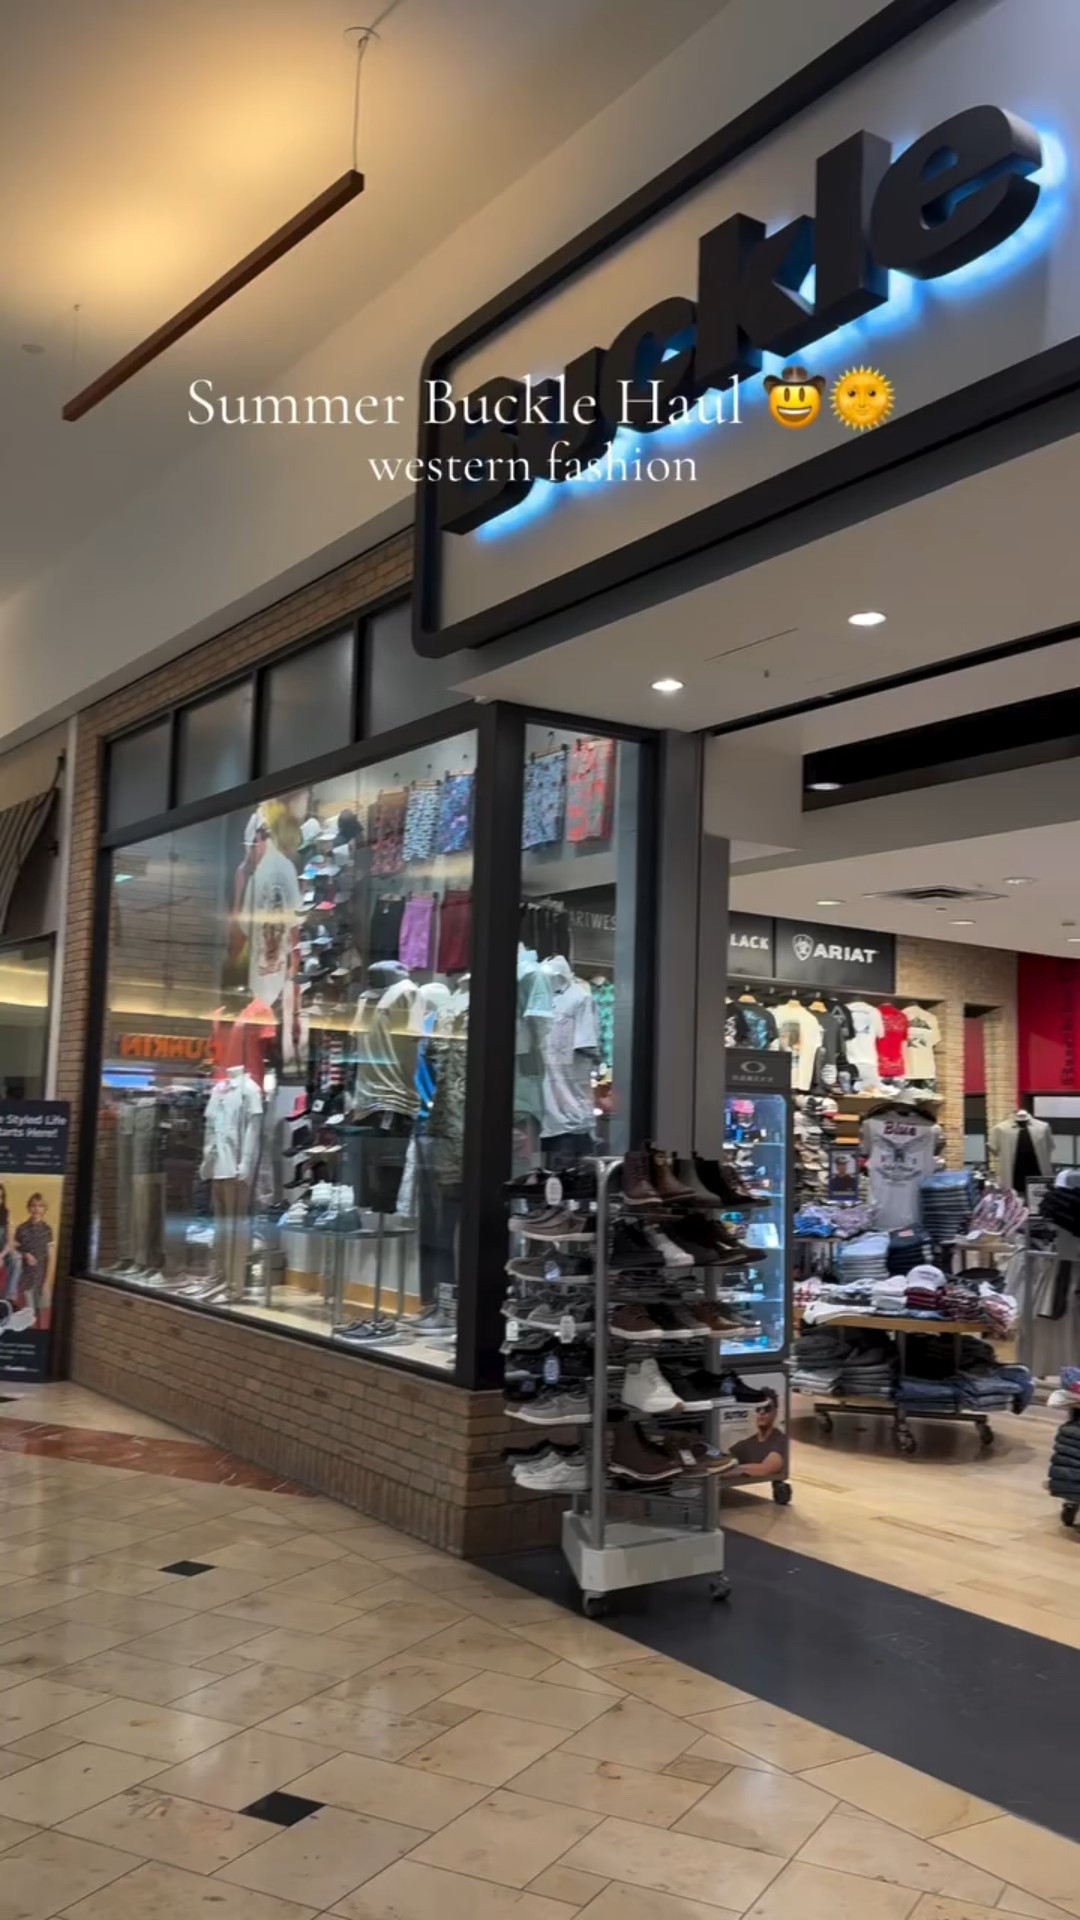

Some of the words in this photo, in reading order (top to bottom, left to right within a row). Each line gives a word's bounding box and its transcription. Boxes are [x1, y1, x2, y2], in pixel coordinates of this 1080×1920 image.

[438, 104, 1044, 536] Buckle
[729, 932, 770, 952] LACK
[812, 942, 879, 964] ARIAT
